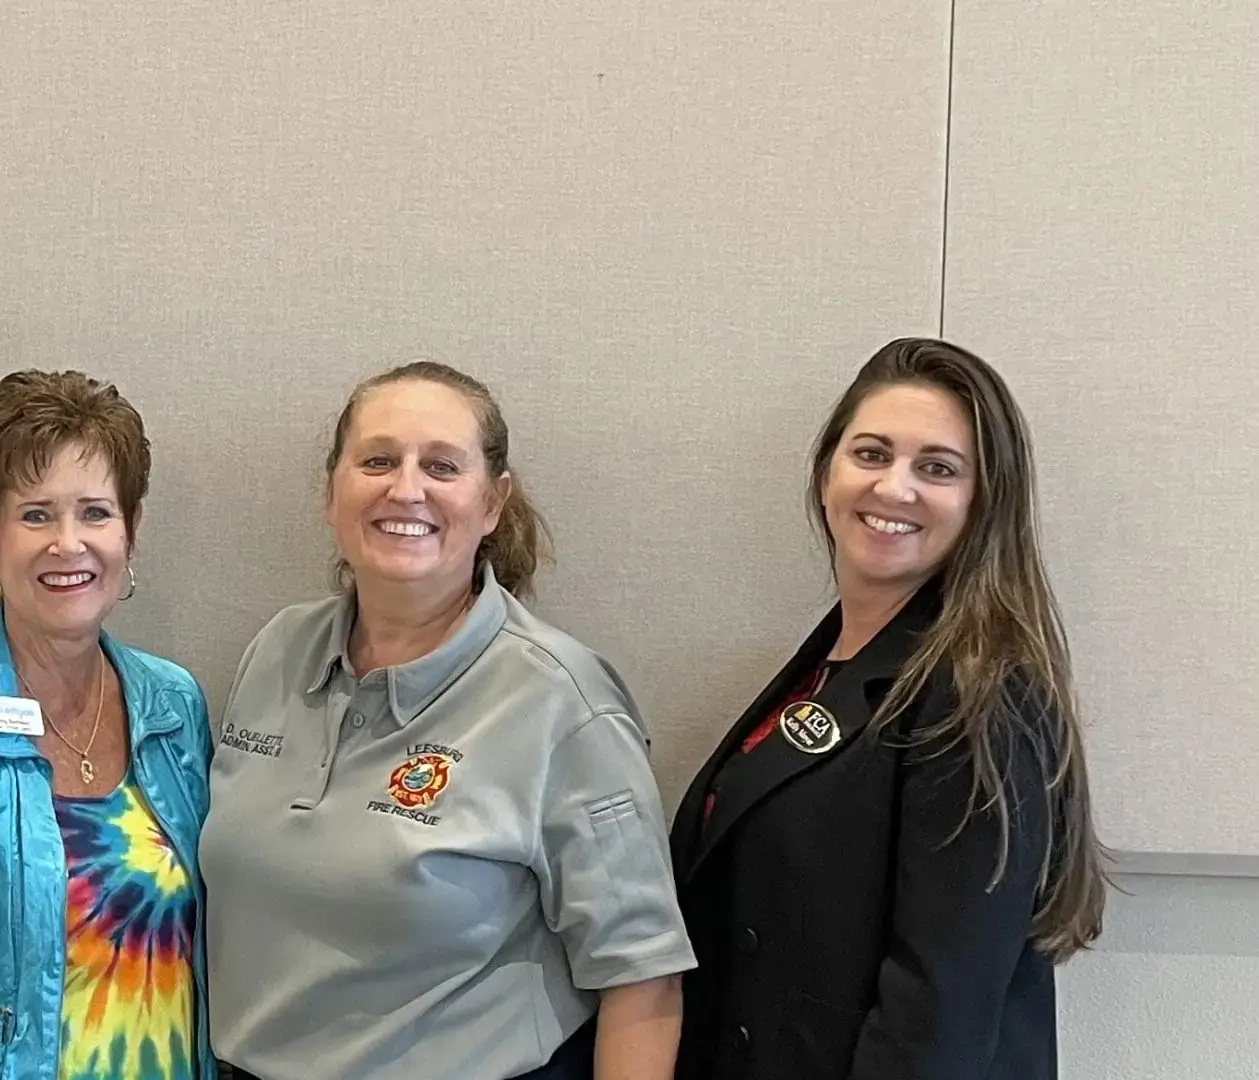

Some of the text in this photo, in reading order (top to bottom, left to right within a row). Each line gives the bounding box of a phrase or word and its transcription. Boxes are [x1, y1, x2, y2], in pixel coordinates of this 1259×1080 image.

[807, 711, 831, 735] FCA
[366, 800, 440, 825] FIRE RESCUE
